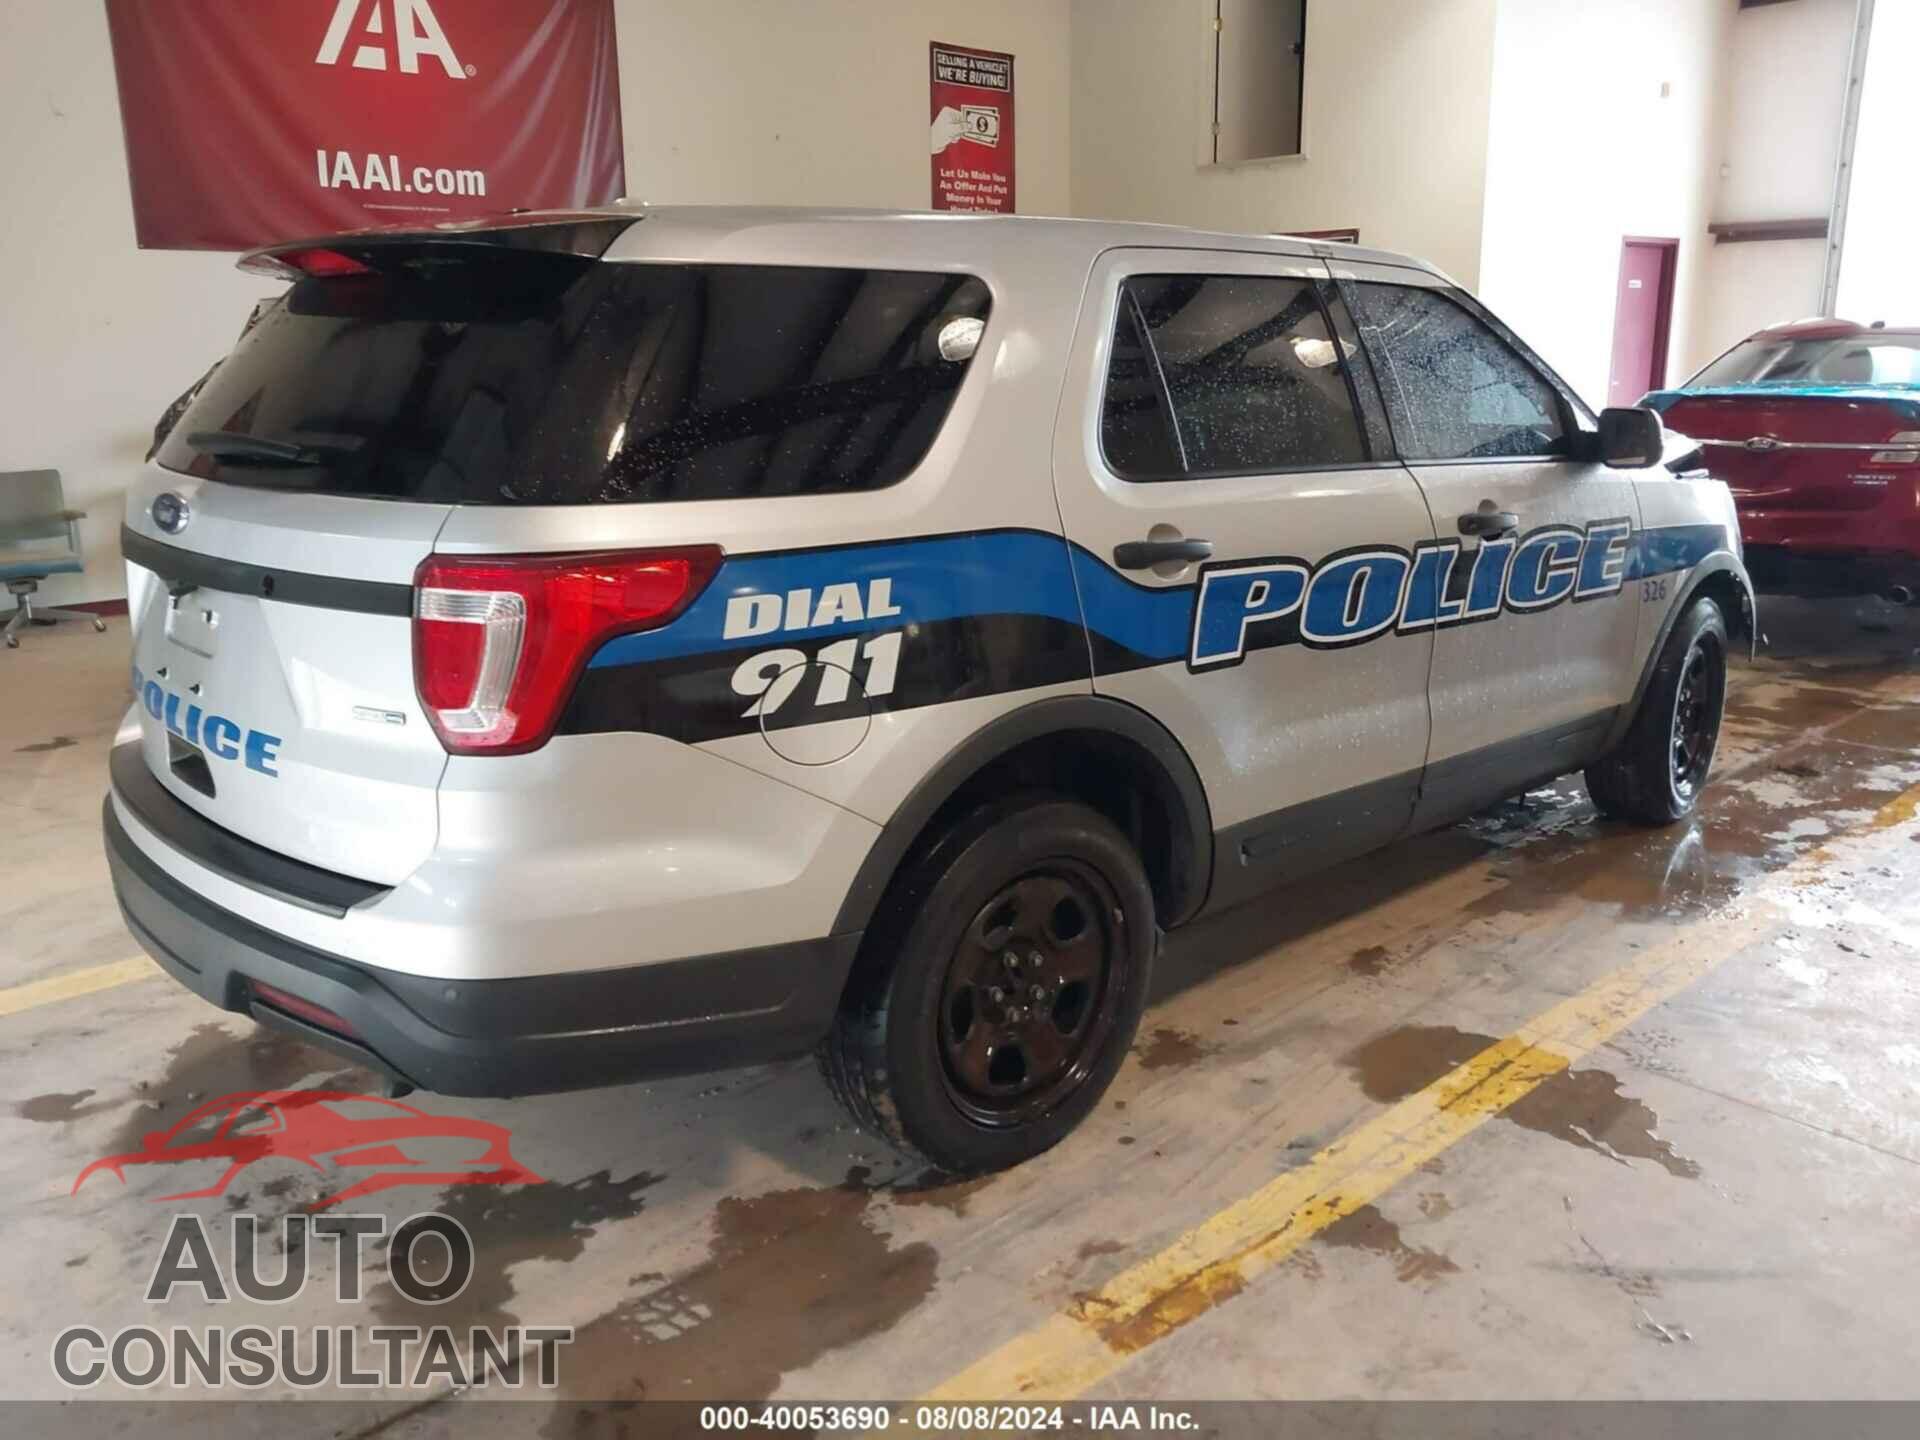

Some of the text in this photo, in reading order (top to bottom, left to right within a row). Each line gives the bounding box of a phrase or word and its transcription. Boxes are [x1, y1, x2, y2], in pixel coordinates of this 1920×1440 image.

[937, 53, 1008, 73] SELLING A VEHICLE?
[938, 66, 1006, 88] WE'RE BUYING!
[316, 150, 486, 196] IAAI.com
[940, 168, 955, 177] Let
[957, 168, 969, 179] Us
[970, 170, 991, 180] Make
[940, 180, 1008, 194] An Offer And Put
[946, 192, 975, 204] Money
[976, 195, 985, 204] In
[1188, 516, 1634, 674] POLICE
[1643, 580, 1666, 603] 326
[723, 577, 901, 640] DIAL
[731, 631, 903, 718] 911
